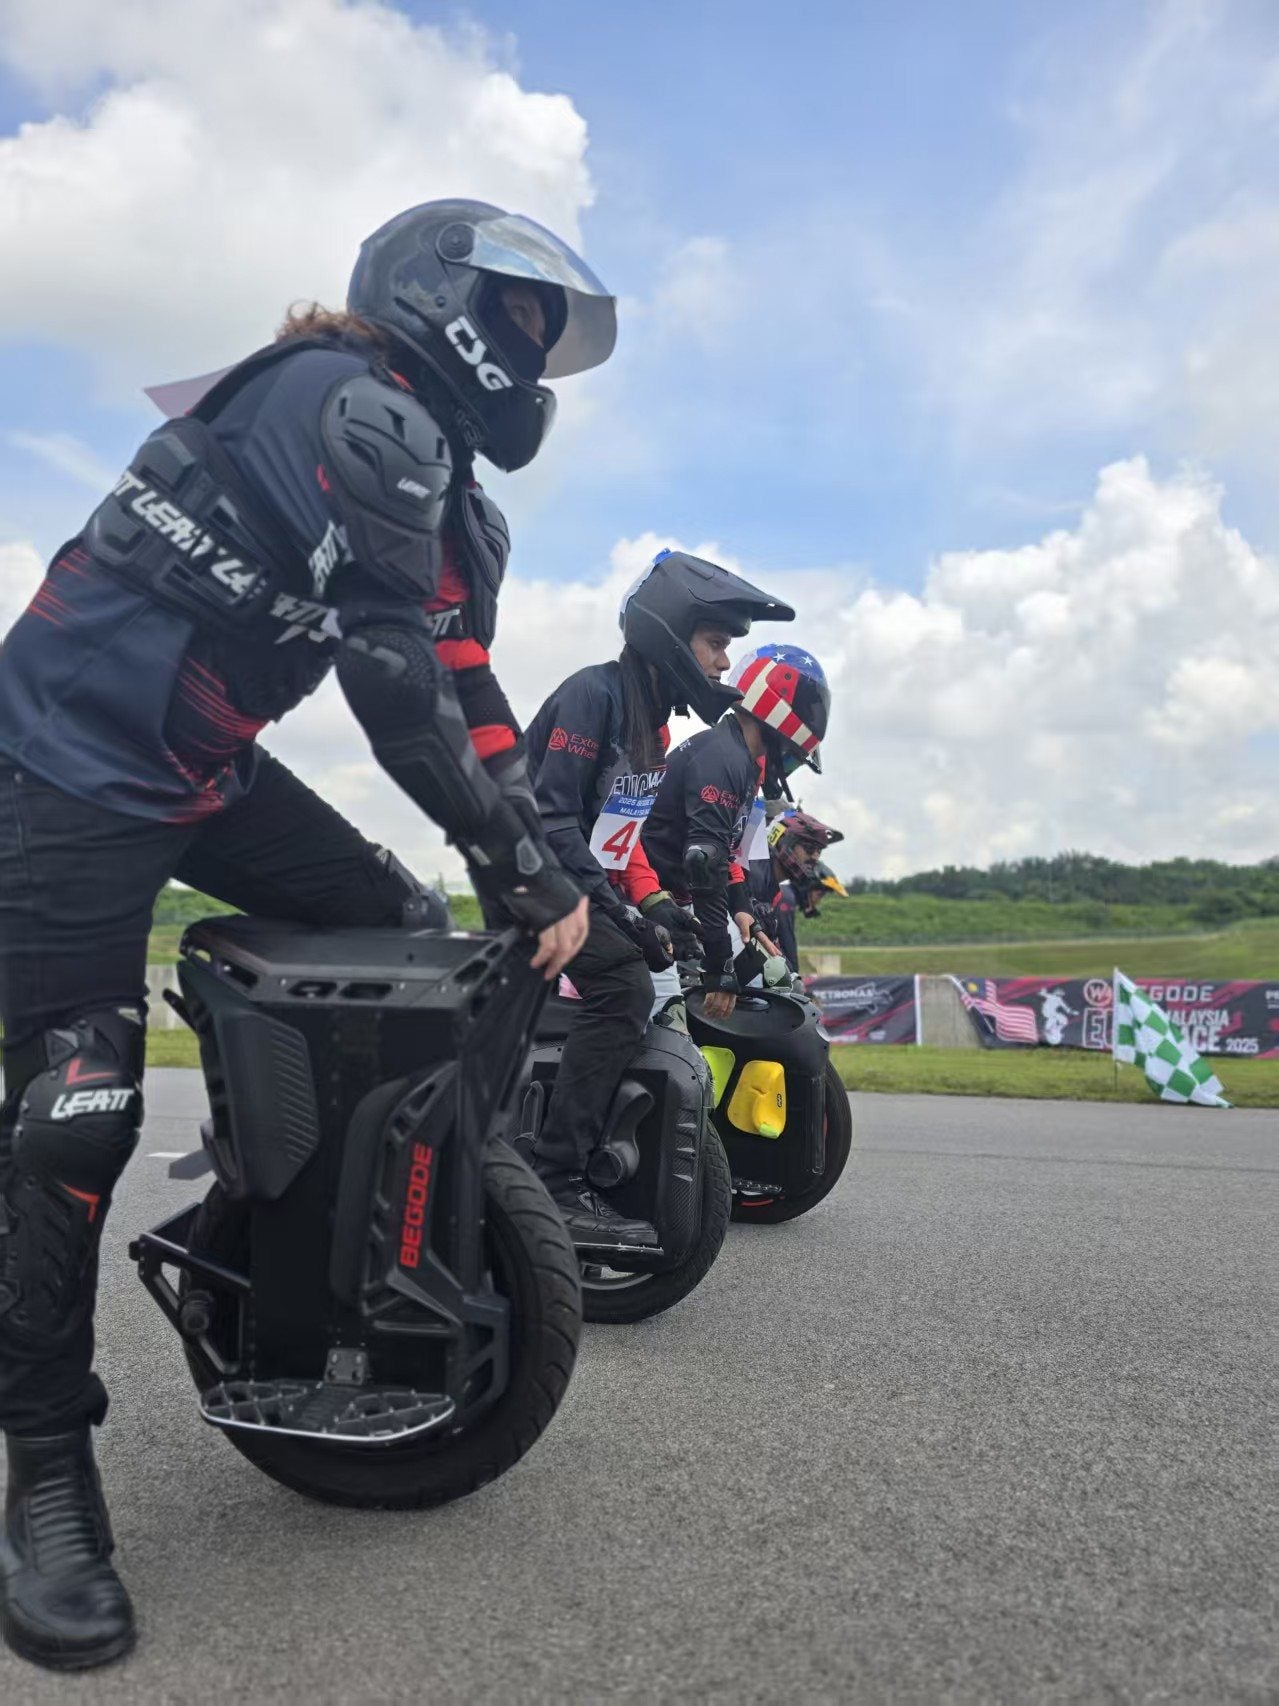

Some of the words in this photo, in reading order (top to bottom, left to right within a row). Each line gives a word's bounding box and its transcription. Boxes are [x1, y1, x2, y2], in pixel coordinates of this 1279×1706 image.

[602, 820, 638, 861] 4
[1226, 1037, 1259, 1053] 2025
[51, 1088, 134, 1120] LEATT
[400, 1142, 433, 1268] BEGODE
